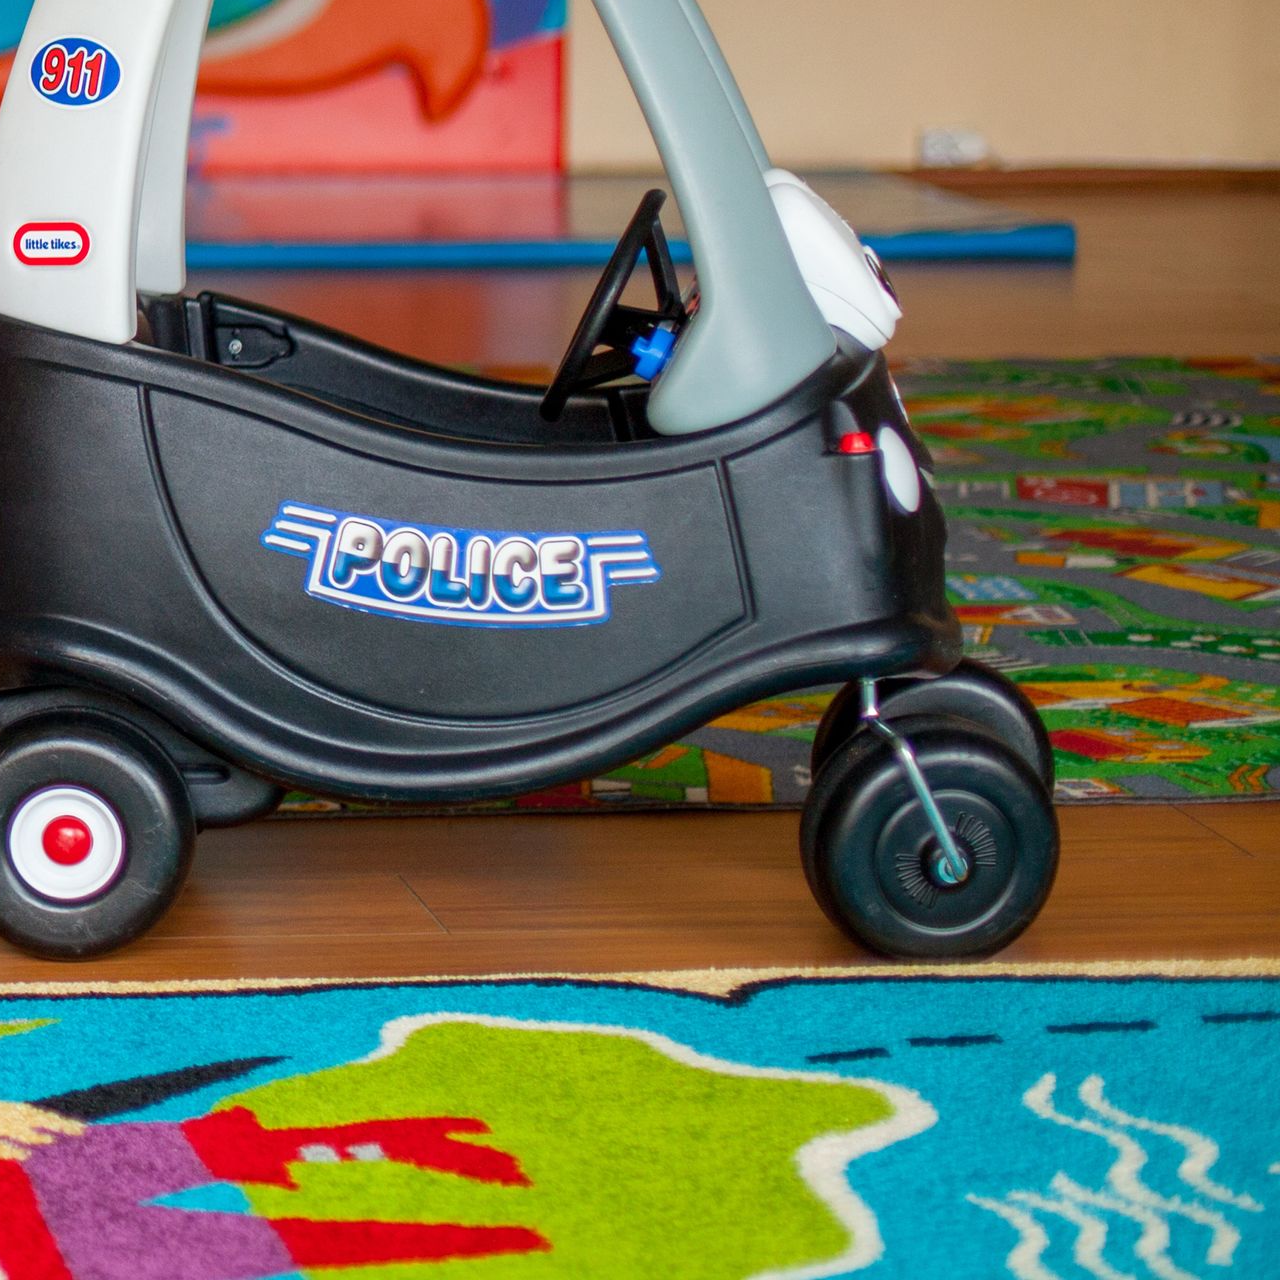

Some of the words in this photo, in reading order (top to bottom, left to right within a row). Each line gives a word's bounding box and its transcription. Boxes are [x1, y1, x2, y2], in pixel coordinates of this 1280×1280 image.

[40, 45, 105, 99] 911
[25, 238, 49, 250] little
[50, 238, 77, 250] tikes
[329, 517, 588, 612] POLICE
